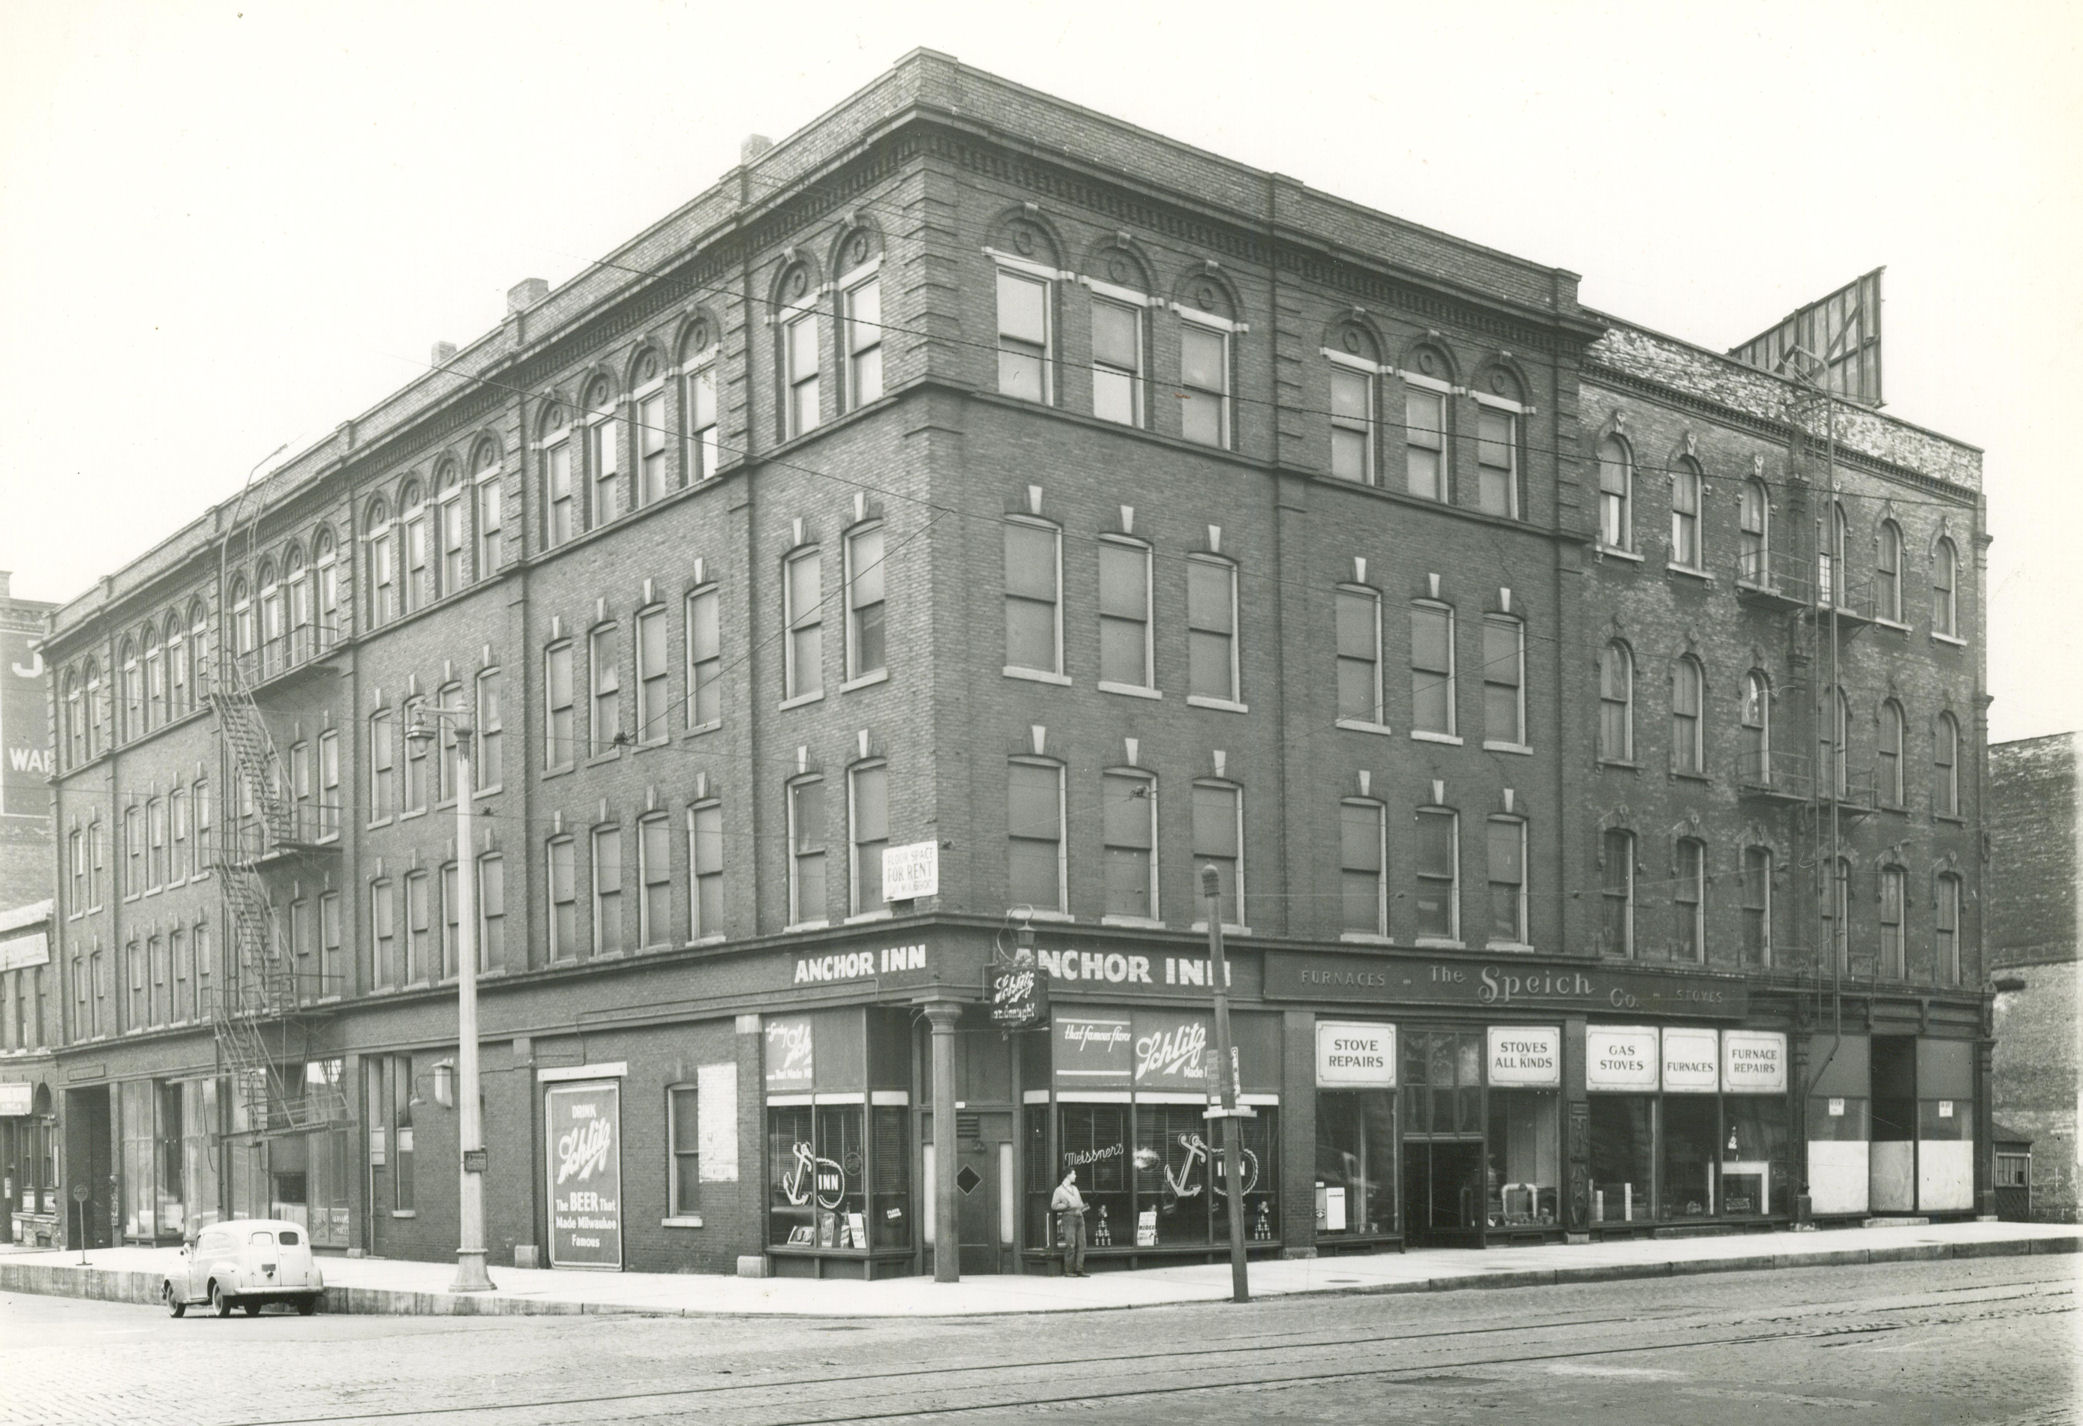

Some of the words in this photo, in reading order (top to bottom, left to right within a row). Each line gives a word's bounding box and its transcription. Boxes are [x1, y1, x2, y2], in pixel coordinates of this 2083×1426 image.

[887, 866, 904, 883] FOR
[906, 861, 932, 880] RENT
[794, 951, 875, 984] ANCHOR
[881, 943, 926, 973] INN
[993, 970, 1035, 1003] Schlitz
[1301, 968, 1385, 987] FURNACES
[1430, 964, 1467, 983] The
[1477, 965, 1595, 1004] Speich
[1609, 987, 1640, 1009] Co.
[1676, 989, 1723, 1004] STOVES
[1064, 1024, 1084, 1040] that
[1080, 1025, 1111, 1052] famous
[1108, 1025, 1132, 1053] flavor
[1334, 1039, 1378, 1052] STOVE
[1135, 1022, 1206, 1080] Schlitz
[1500, 1041, 1548, 1054] STOVES
[1609, 1045, 1635, 1056] GAS
[1732, 1049, 1777, 1060] FURNACE
[1328, 1055, 1384, 1069] REPAIRS
[1494, 1057, 1517, 1069] ALL
[1519, 1057, 1553, 1069] KINDS
[1600, 1059, 1644, 1071] STOVES
[1667, 1062, 1714, 1073] FURNACES
[1733, 1063, 1775, 1073] REPAIRS
[1184, 1065, 1203, 1078] Made
[571, 1104, 597, 1119] DRINK
[557, 1117, 611, 1185] Schlitz
[1217, 1160, 1245, 1177] IN
[818, 1174, 839, 1191] INN
[556, 1199, 569, 1212] The
[570, 1191, 598, 1213] BEER
[600, 1197, 616, 1212] That
[556, 1216, 577, 1229] Made
[577, 1216, 617, 1230] Milwaukee
[571, 1233, 600, 1248] Famous
